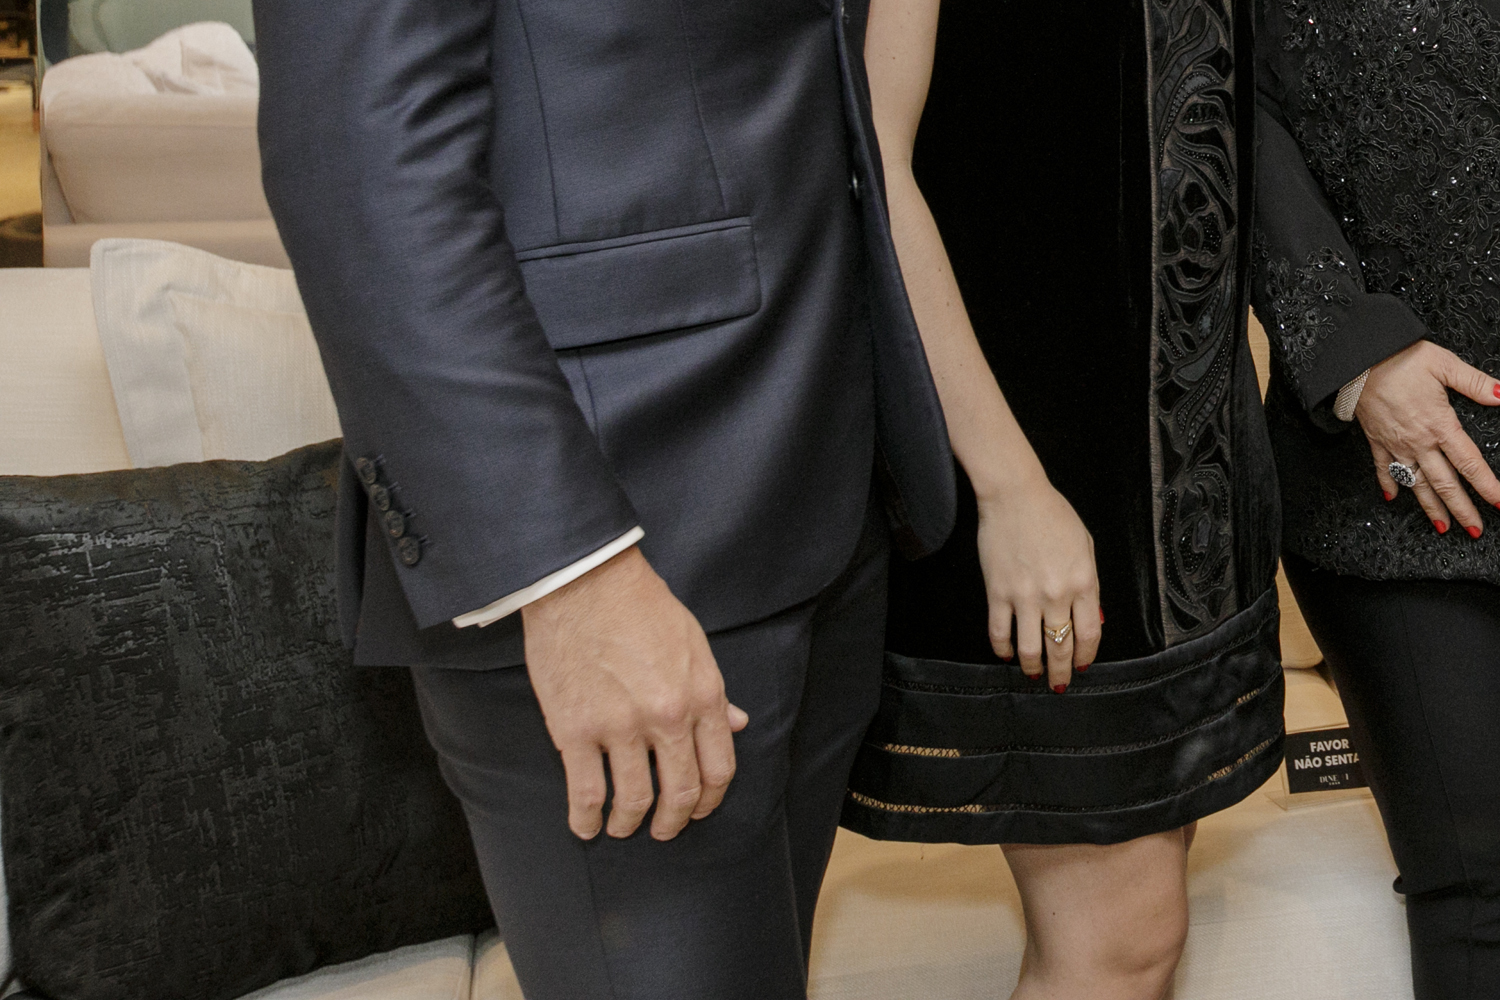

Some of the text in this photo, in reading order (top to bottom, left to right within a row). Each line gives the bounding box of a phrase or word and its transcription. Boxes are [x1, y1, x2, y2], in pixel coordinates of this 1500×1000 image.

[1310, 738, 1349, 752] FAVOR
[1294, 753, 1360, 770] NÃO SENTA
